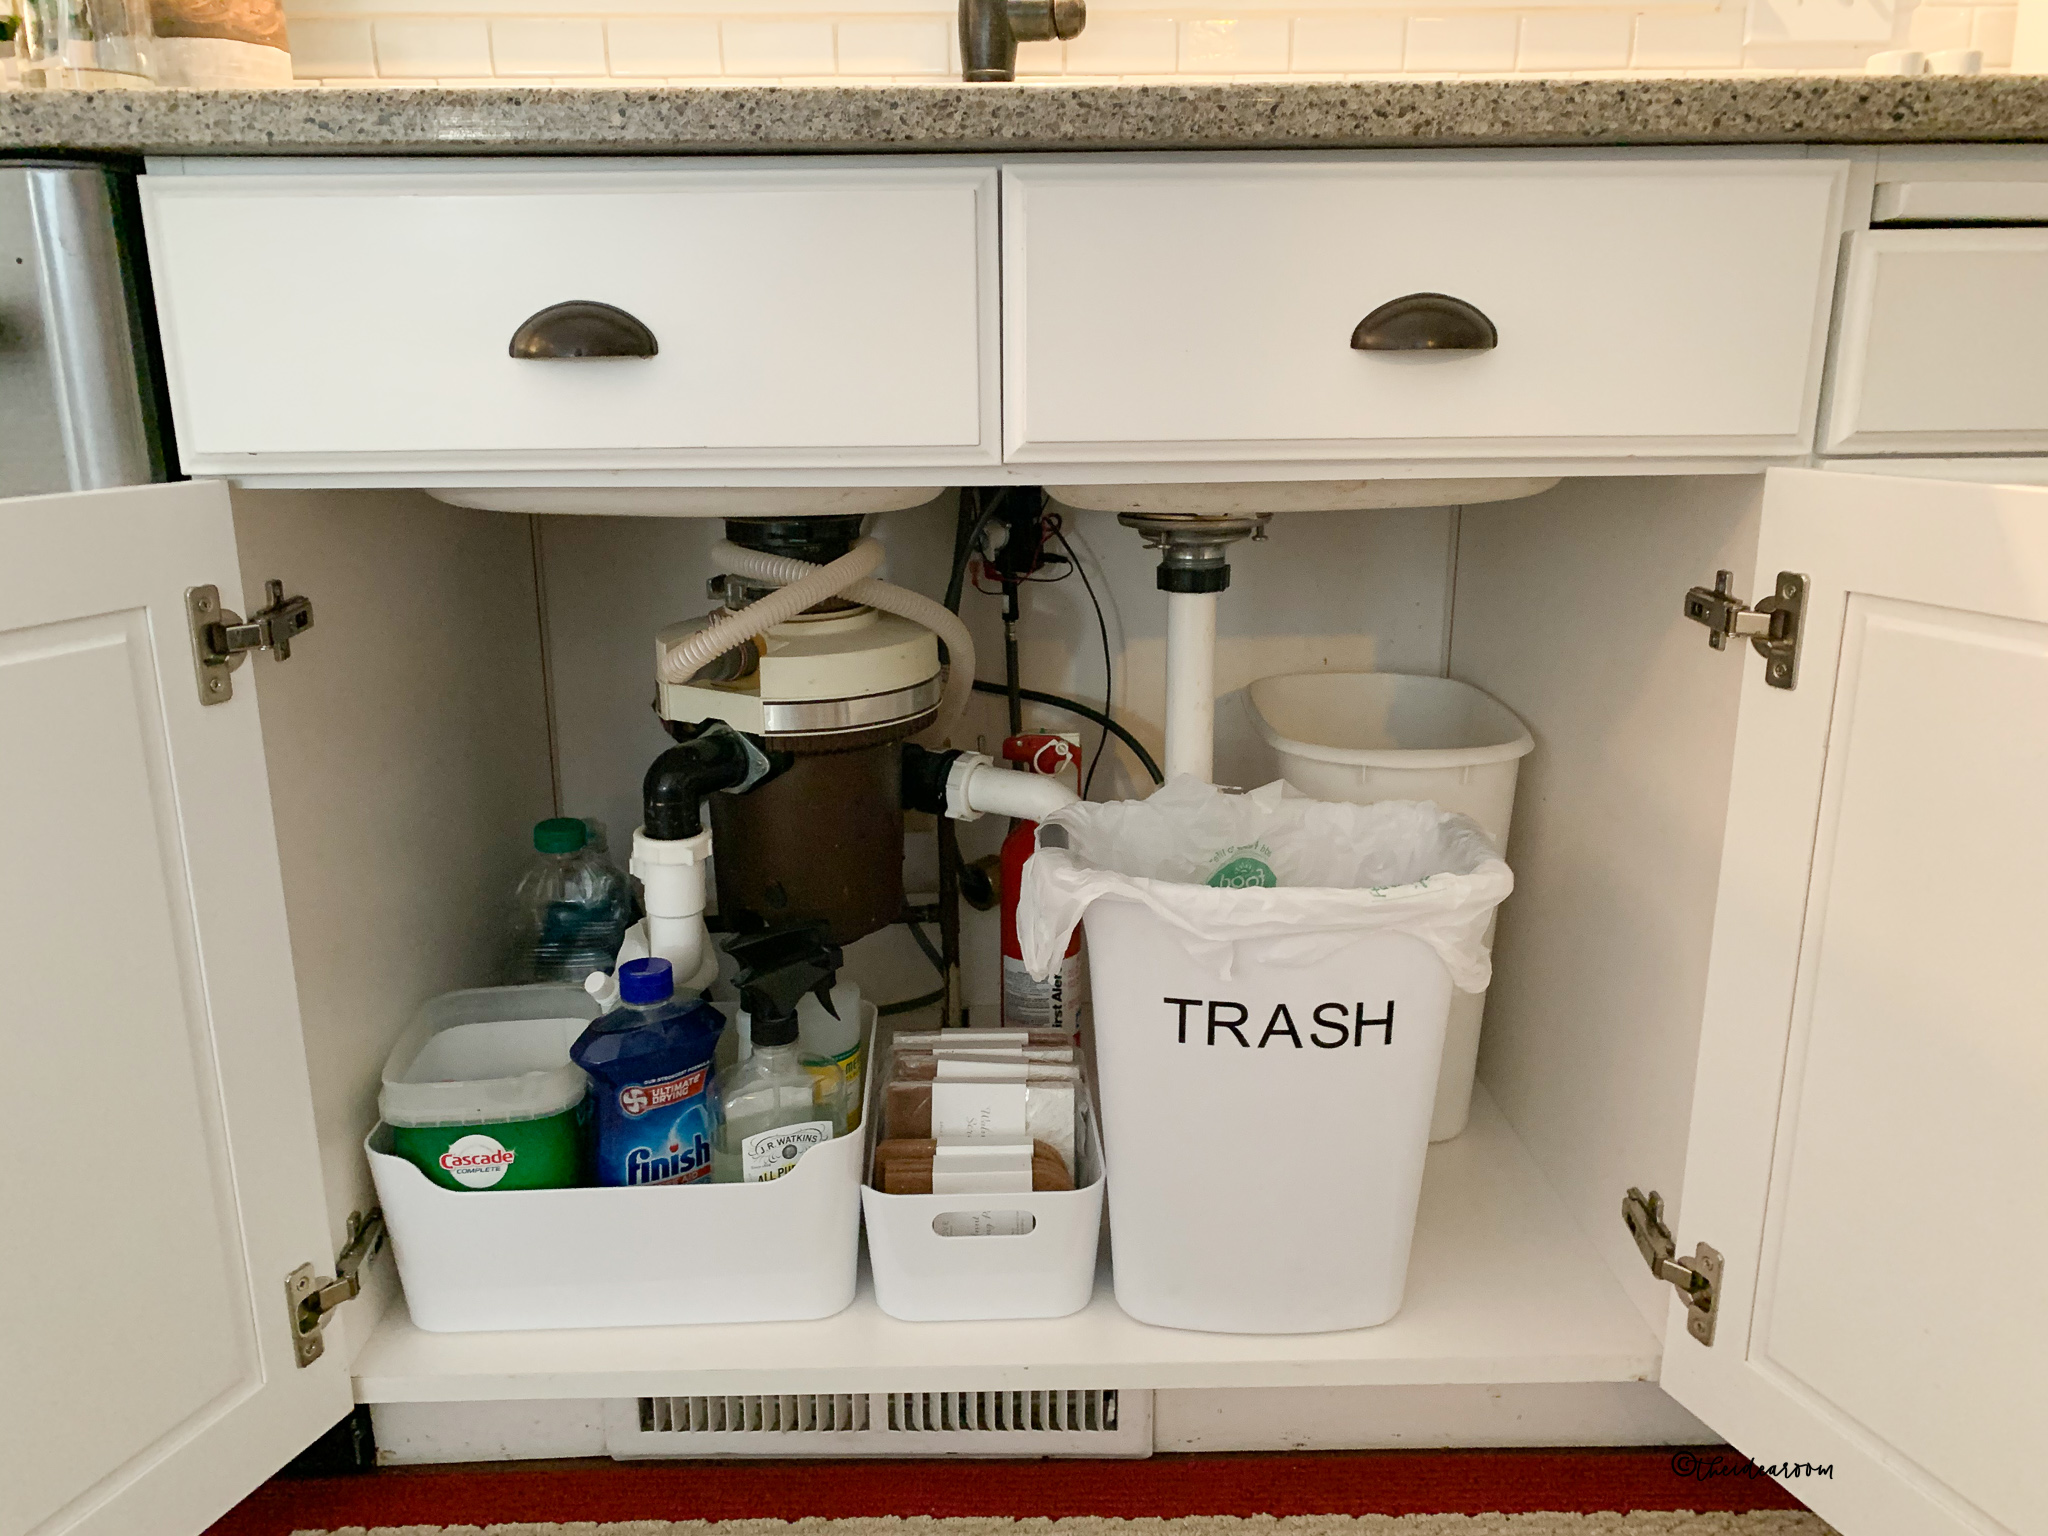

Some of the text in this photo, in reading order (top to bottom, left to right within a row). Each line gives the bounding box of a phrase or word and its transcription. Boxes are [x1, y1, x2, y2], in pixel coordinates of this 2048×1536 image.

[1051, 967, 1063, 1028] irst Aler
[1163, 997, 1395, 1049] TRASH
[652, 1073, 700, 1097] ULTIMATE
[652, 1086, 689, 1105] DRYING
[776, 1134, 818, 1146] WATKINS
[440, 1149, 514, 1169] Cascade
[627, 1133, 711, 1186] finish
[456, 1166, 501, 1175] COMPLETE
